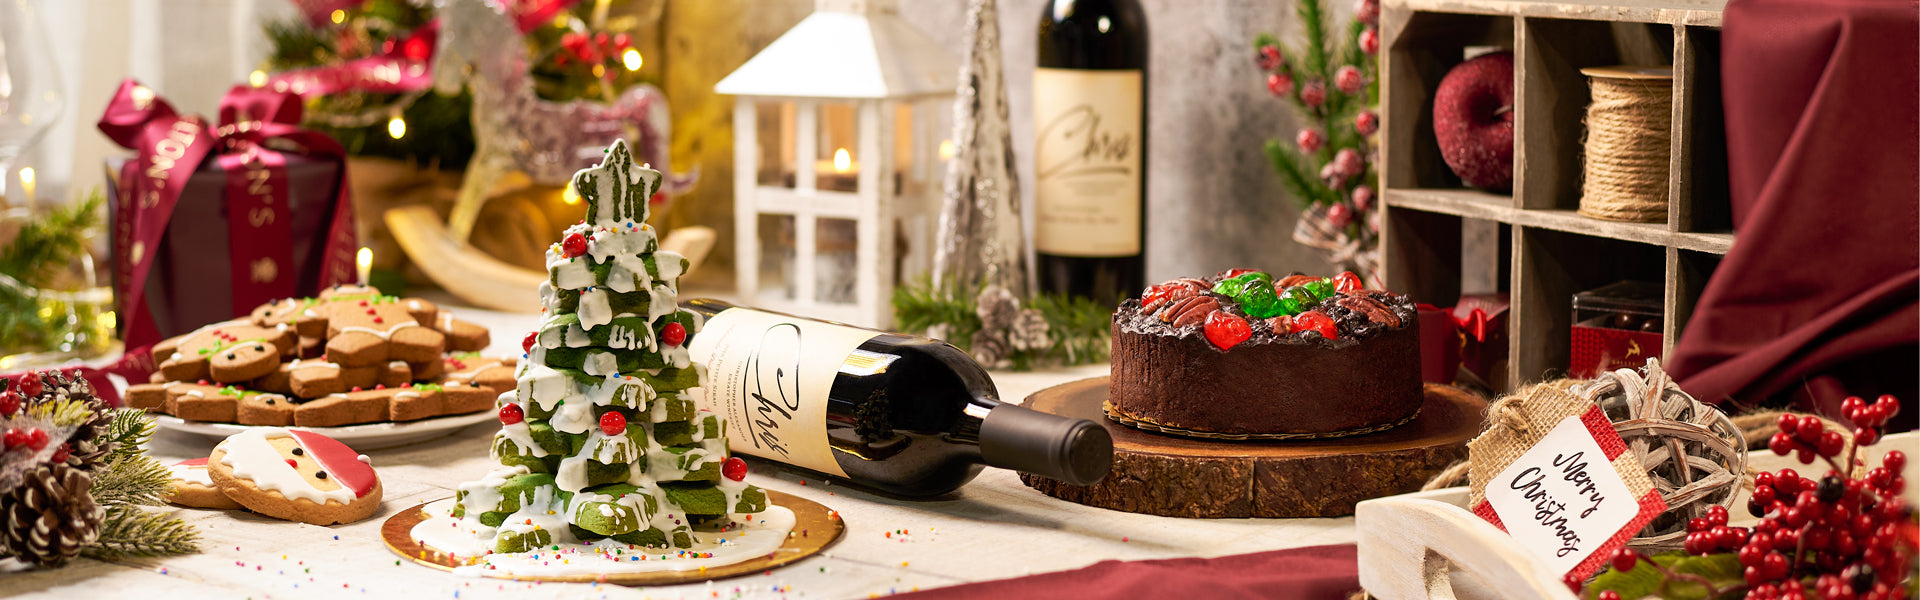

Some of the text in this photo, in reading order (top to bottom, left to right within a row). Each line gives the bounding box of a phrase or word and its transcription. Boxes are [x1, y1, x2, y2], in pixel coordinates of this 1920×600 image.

[1037, 104, 1131, 181] Chris
[751, 322, 802, 459] Chris
[1510, 451, 1605, 557] Merry Christmas
